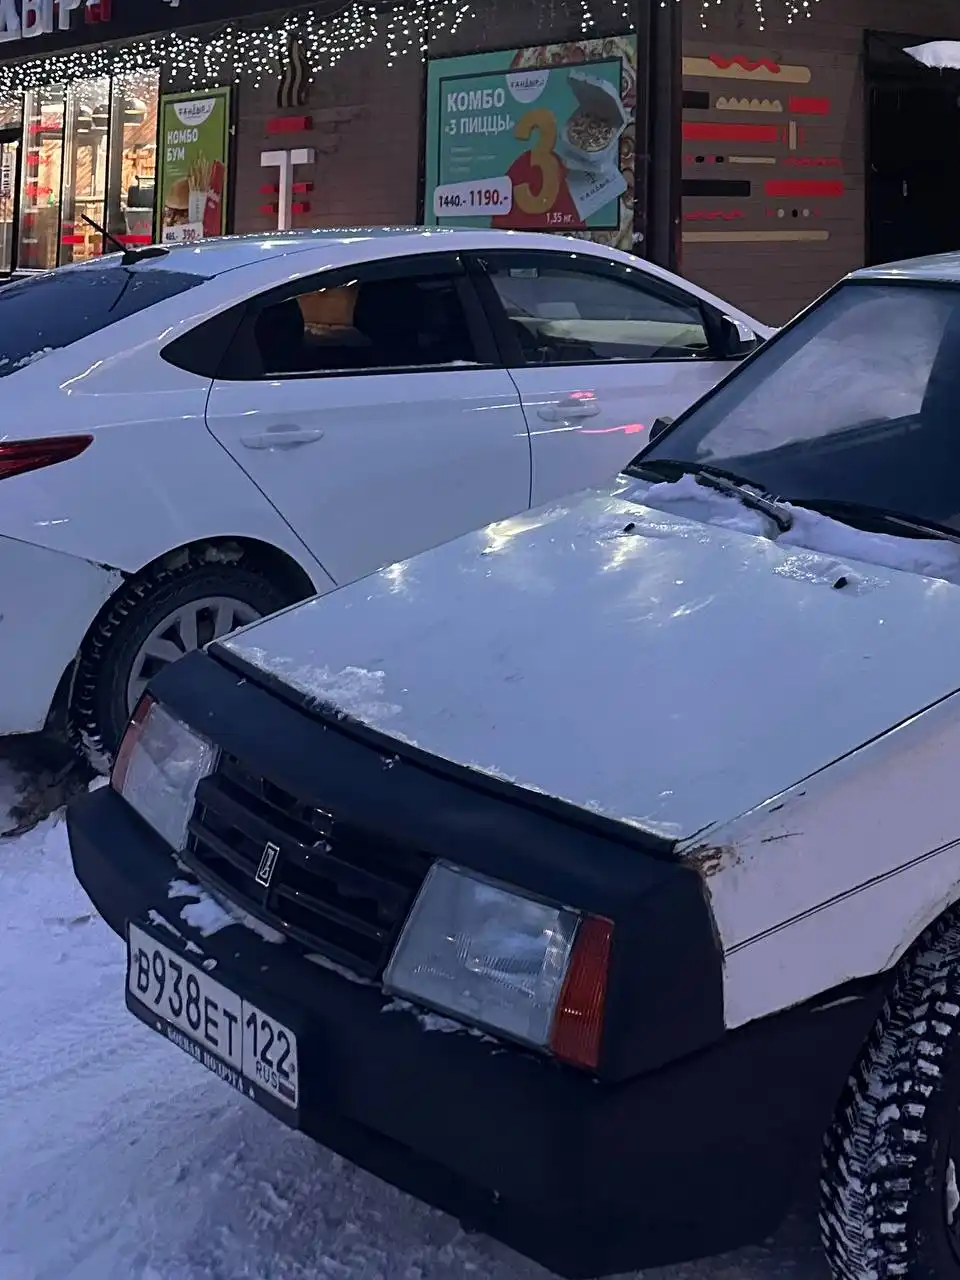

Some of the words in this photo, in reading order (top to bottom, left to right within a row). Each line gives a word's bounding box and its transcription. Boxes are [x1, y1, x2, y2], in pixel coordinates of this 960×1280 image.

[447, 87, 505, 112] КОМБО
[167, 128, 199, 145] КОМБО
[166, 146, 185, 162] БУМ
[469, 189, 509, 207] 1190.-
[137, 947, 239, 1057] В938ЕТ
[246, 1011, 291, 1080] 122
[255, 1059, 279, 1090] RUS
